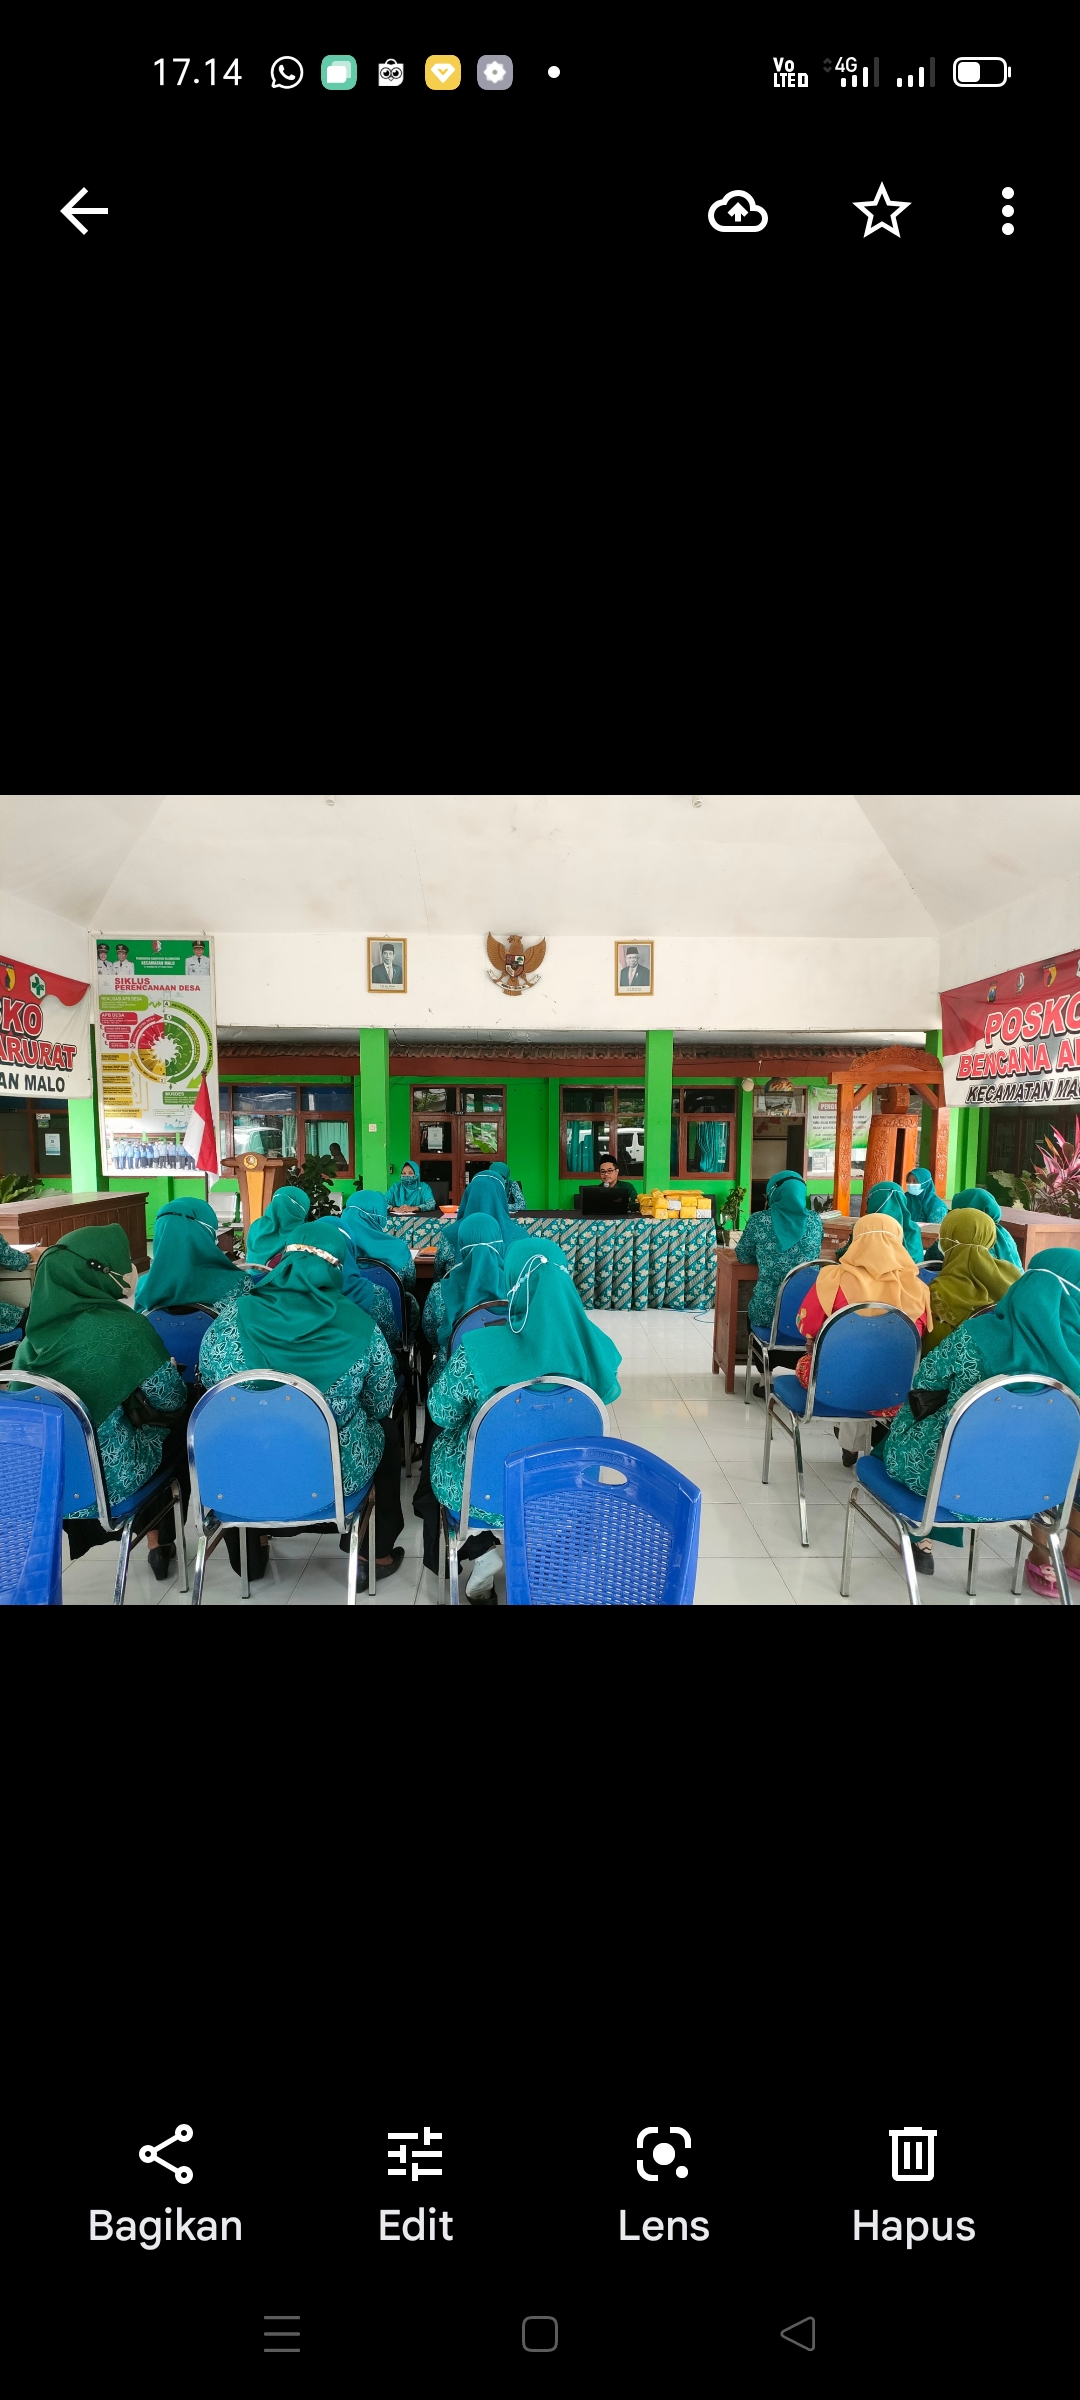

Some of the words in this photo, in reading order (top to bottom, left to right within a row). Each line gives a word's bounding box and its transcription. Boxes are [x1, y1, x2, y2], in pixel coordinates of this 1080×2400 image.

[0, 997, 44, 1041] KO
[957, 1043, 1052, 1081] BENCANA
[25, 1074, 65, 1093] MALO
[965, 1081, 1054, 1105] KECAMATAN
